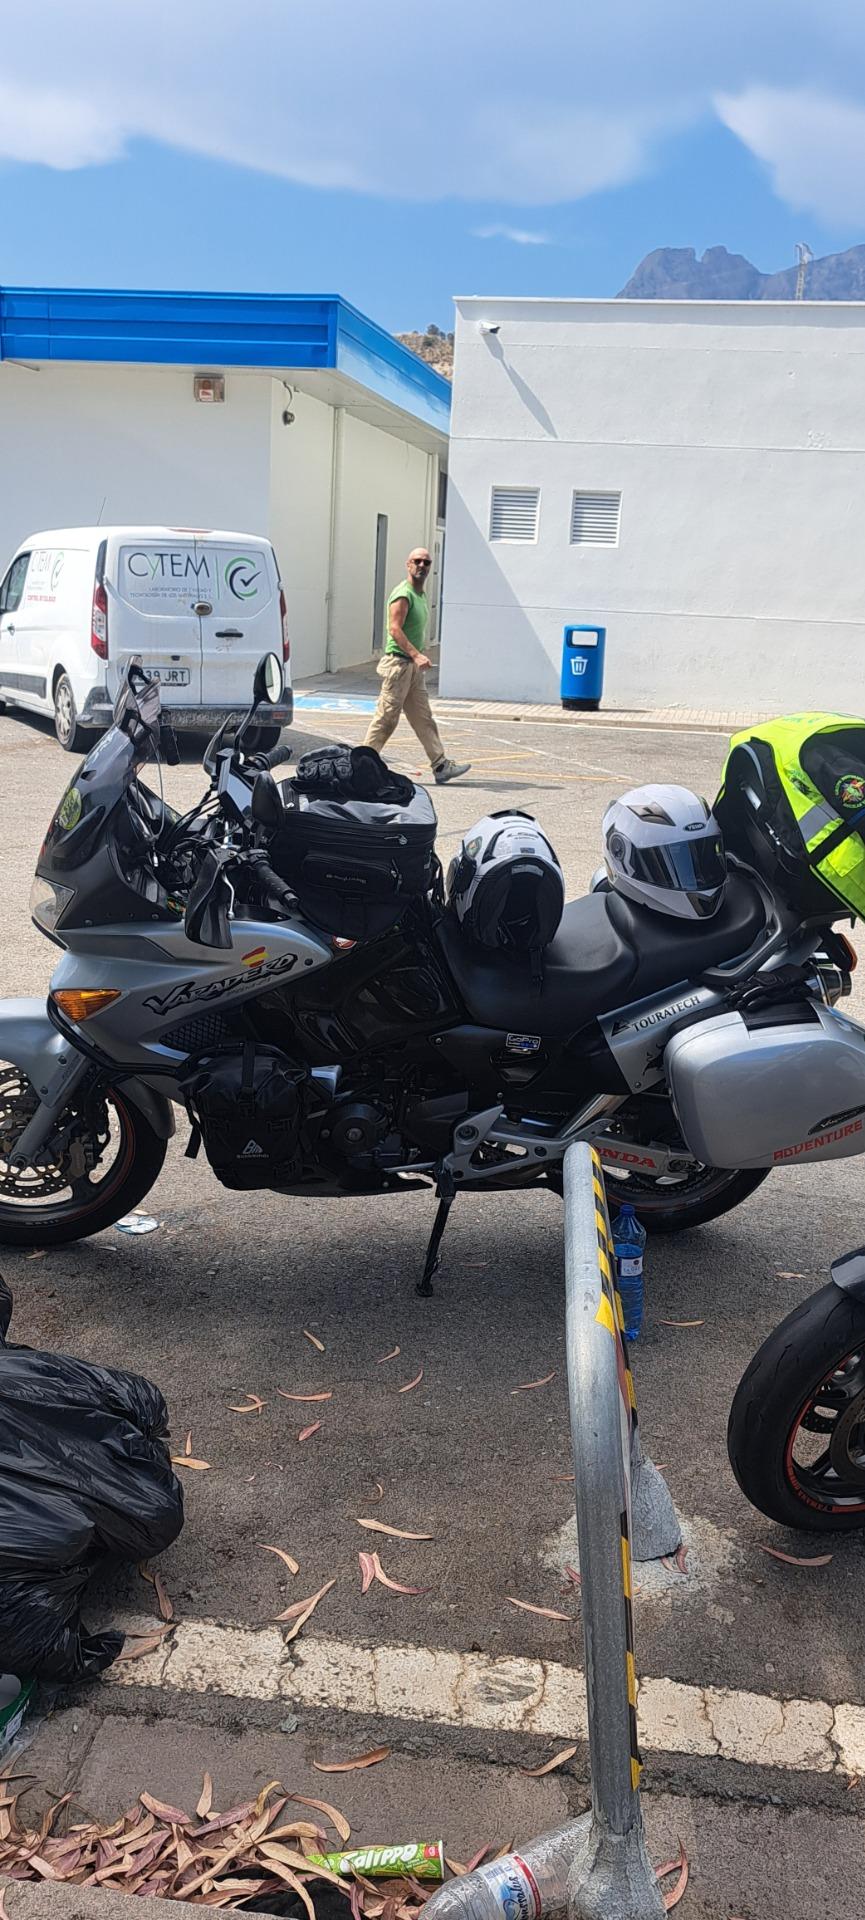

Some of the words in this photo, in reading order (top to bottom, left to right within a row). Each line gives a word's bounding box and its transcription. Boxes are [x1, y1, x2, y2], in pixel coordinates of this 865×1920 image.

[164, 670, 186, 682] JRT
[142, 953, 298, 1015] VARADERO
[632, 995, 701, 1033] TOURATECH
[508, 1035, 539, 1045] GoPro
[773, 1119, 863, 1161] ADVENTURE
[597, 1147, 657, 1168] NDA
